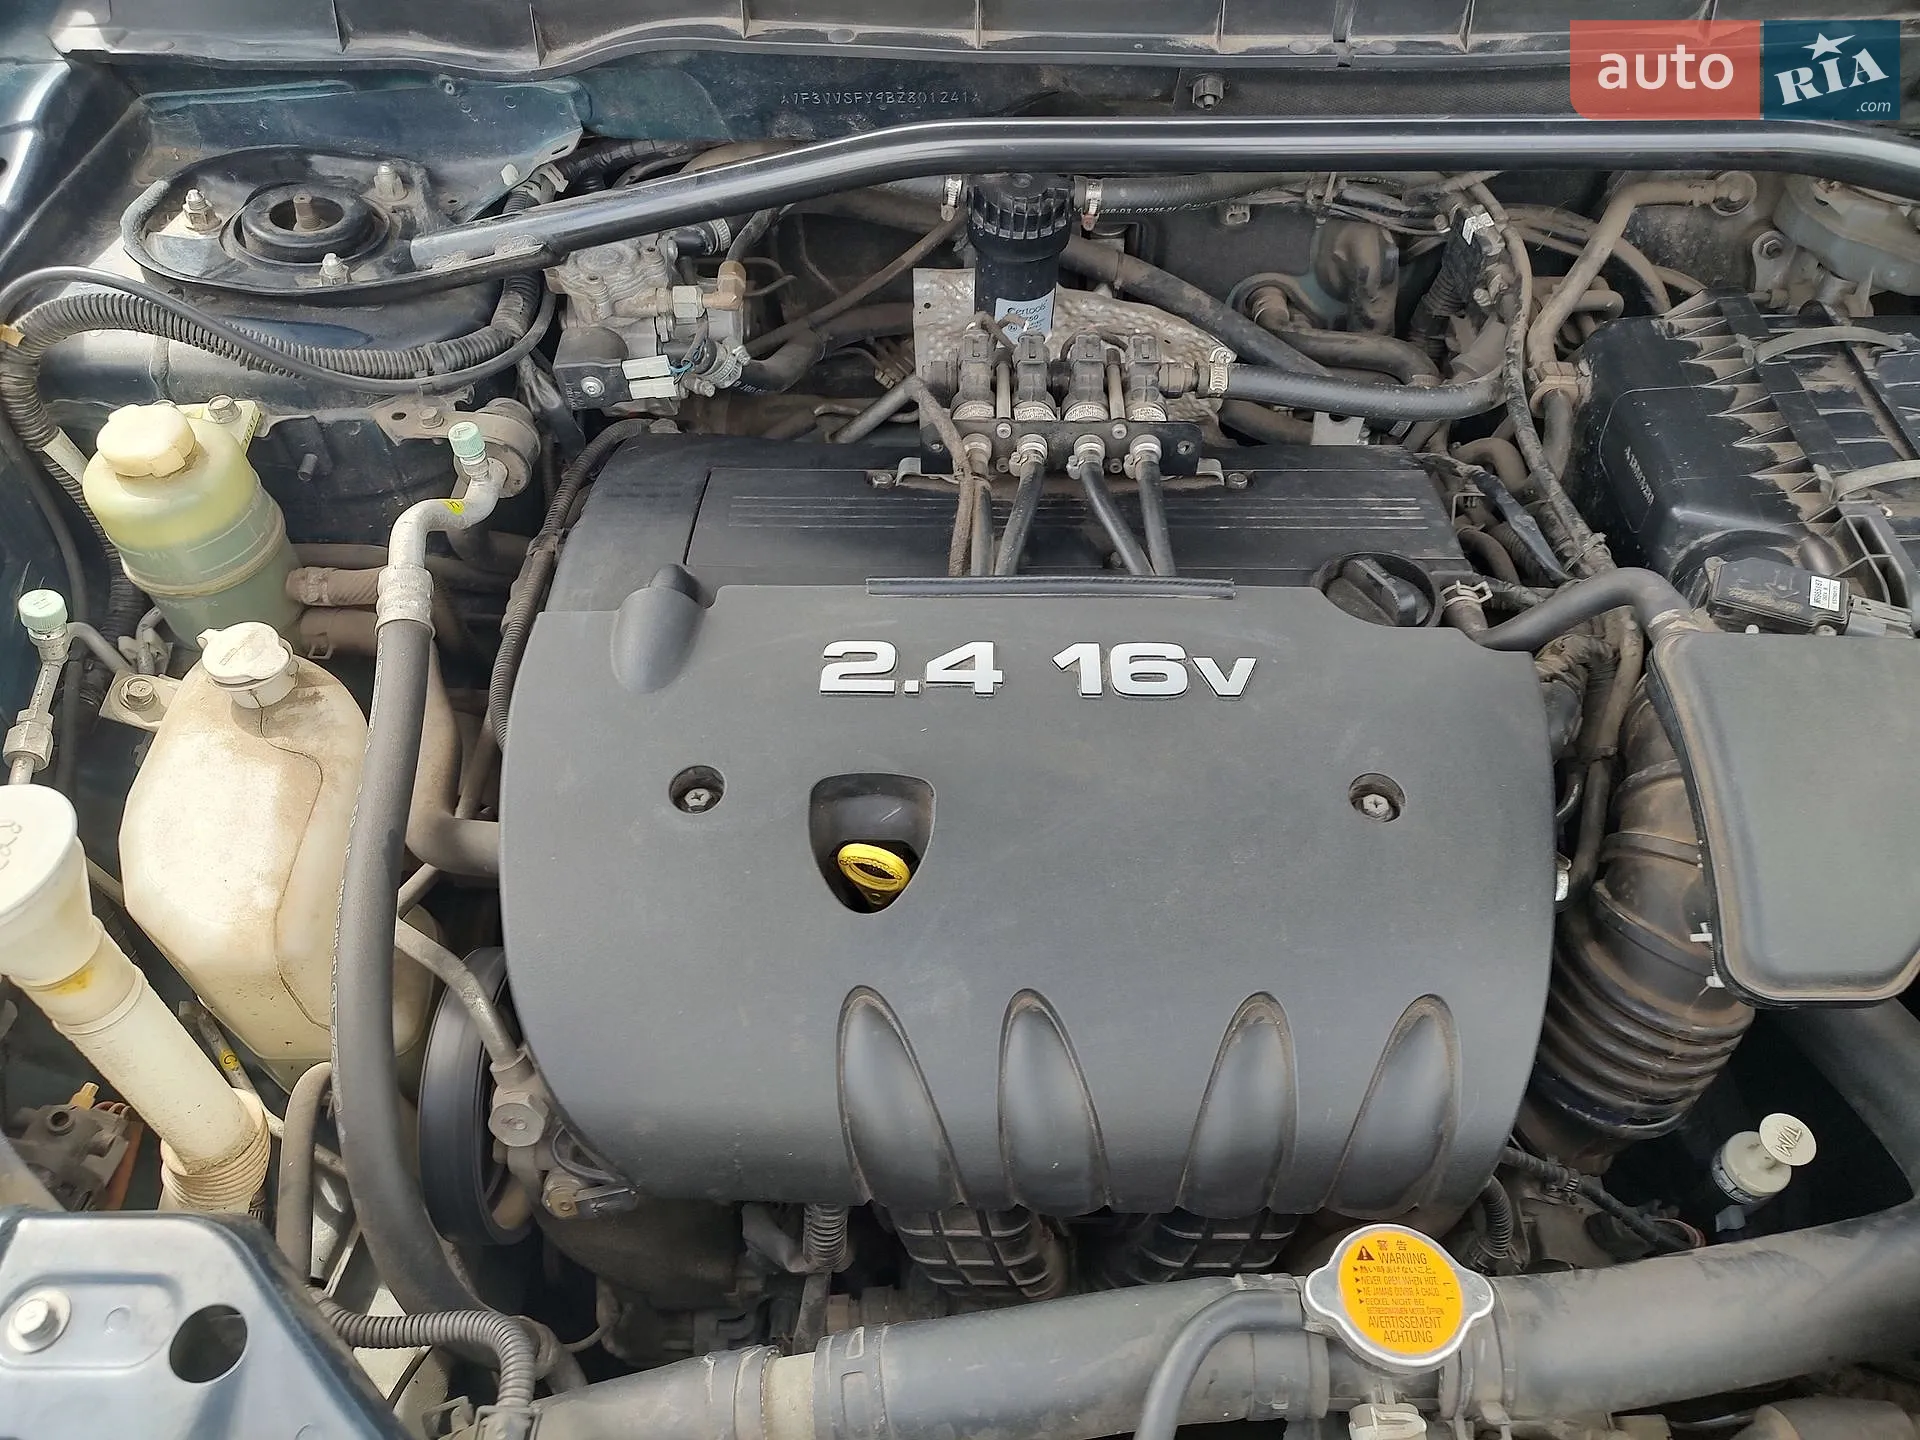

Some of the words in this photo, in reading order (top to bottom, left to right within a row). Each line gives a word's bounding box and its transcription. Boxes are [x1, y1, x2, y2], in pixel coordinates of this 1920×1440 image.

[819, 640, 1004, 696] 2.4
[1052, 641, 1257, 698] 16v
[1775, 1126, 1803, 1157] T/M
[1377, 1251, 1428, 1265] WARNING
[1361, 1275, 1381, 1285] NEVER
[1368, 1316, 1441, 1329] AVERTISSEMENT
[1383, 1330, 1433, 1343] ACHTUNG
